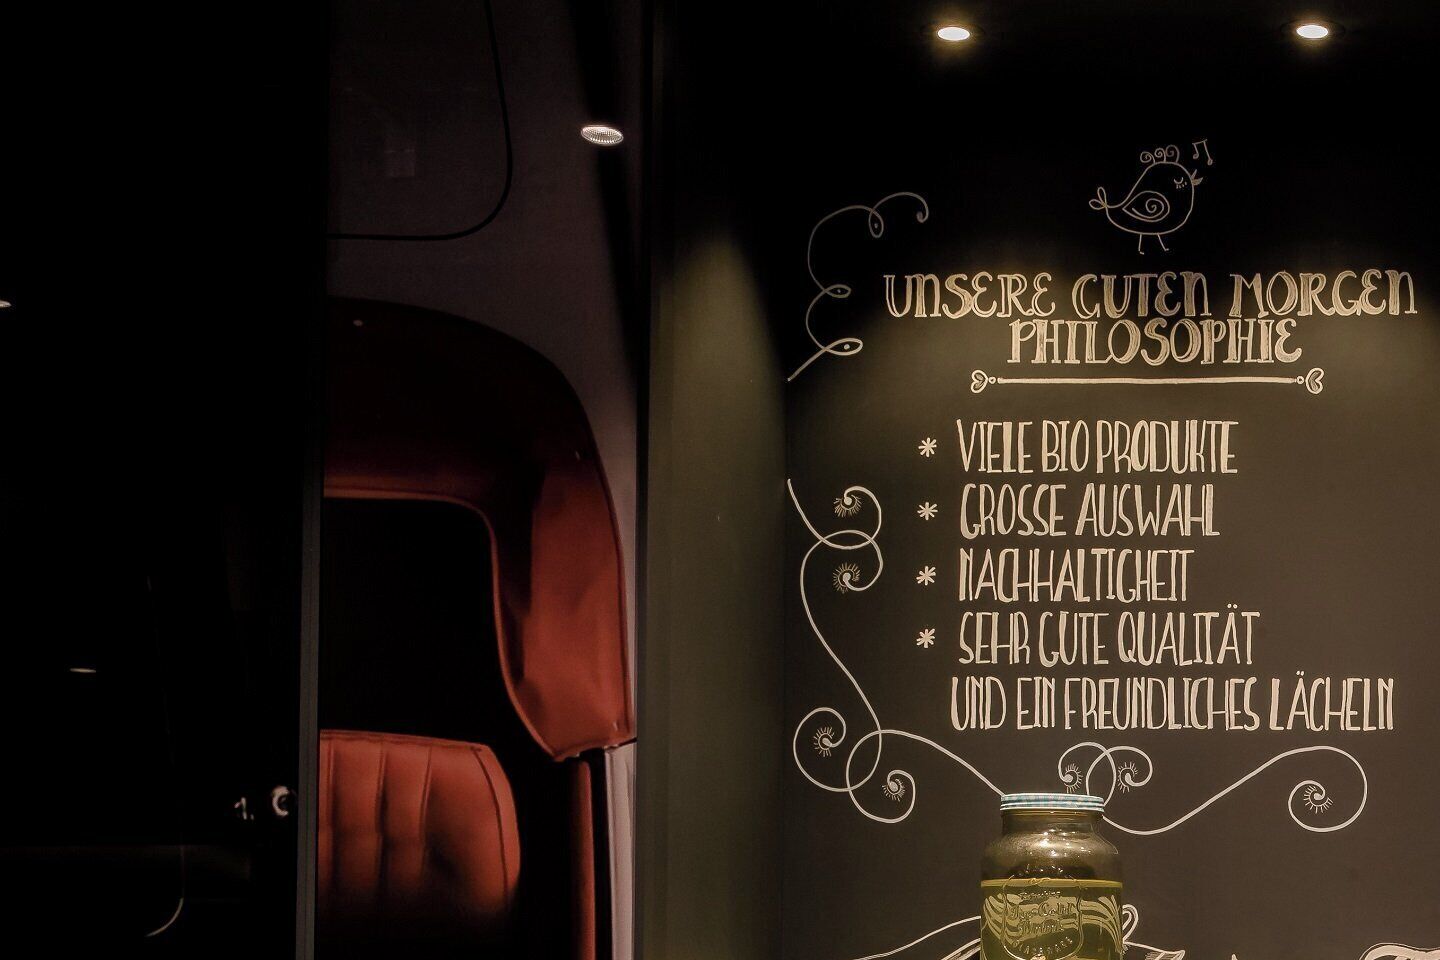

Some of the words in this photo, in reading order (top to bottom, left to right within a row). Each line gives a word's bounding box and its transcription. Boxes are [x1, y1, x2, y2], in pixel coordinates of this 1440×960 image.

[884, 272, 1056, 318] UNSERE
[1071, 271, 1211, 319] GUTEN
[1231, 269, 1417, 317] MORGEN
[1007, 319, 1303, 364] PHILOSOPHIE
[956, 418, 1034, 474] VIELE
[1042, 420, 1090, 474] BIO
[1096, 420, 1239, 474] PRODUKTE
[960, 483, 1067, 539] GROSSE
[1075, 482, 1221, 537] AUSWAHL
[958, 611, 1030, 665] SEHR
[1039, 611, 1110, 667] GUTE
[1118, 603, 1261, 666] QUALITÄT
[951, 676, 1007, 731] UND
[1016, 677, 1056, 730] EIN
[1064, 676, 1258, 731] FREUNDLICHES
[1269, 670, 1396, 732] LÄCHELN
